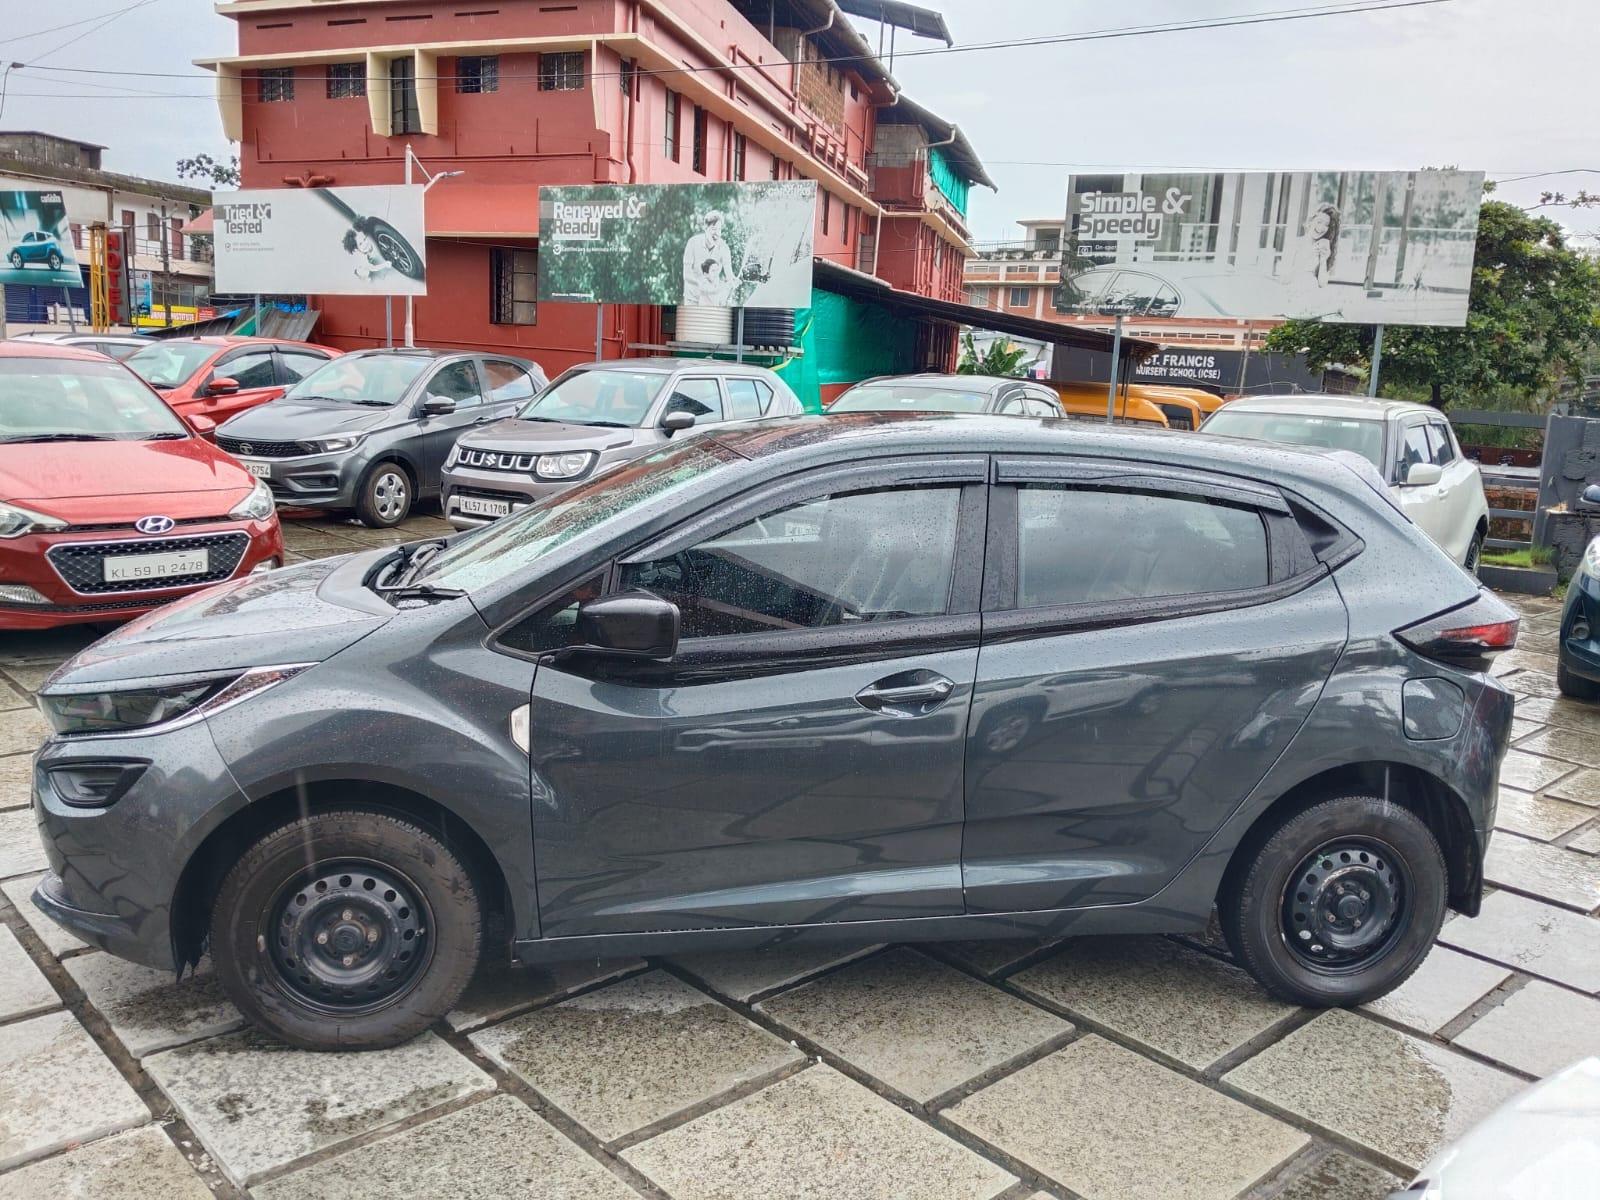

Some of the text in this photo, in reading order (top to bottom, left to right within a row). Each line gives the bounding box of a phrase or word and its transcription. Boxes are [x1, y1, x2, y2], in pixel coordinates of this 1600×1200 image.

[553, 195, 647, 219] Renewed &
[1080, 187, 1193, 215] Simple &
[224, 204, 272, 220] Tried &
[224, 219, 263, 234] Tested
[553, 218, 599, 239] Ready
[1078, 213, 1161, 239] Speedy
[1163, 354, 1215, 368] FRANCIS
[1136, 364, 1221, 380] NURSERY SCHOOL (ICSE)
[251, 465, 270, 476] 6754
[490, 503, 507, 516] 1708
[111, 561, 203, 578] KL 59 R 2478
